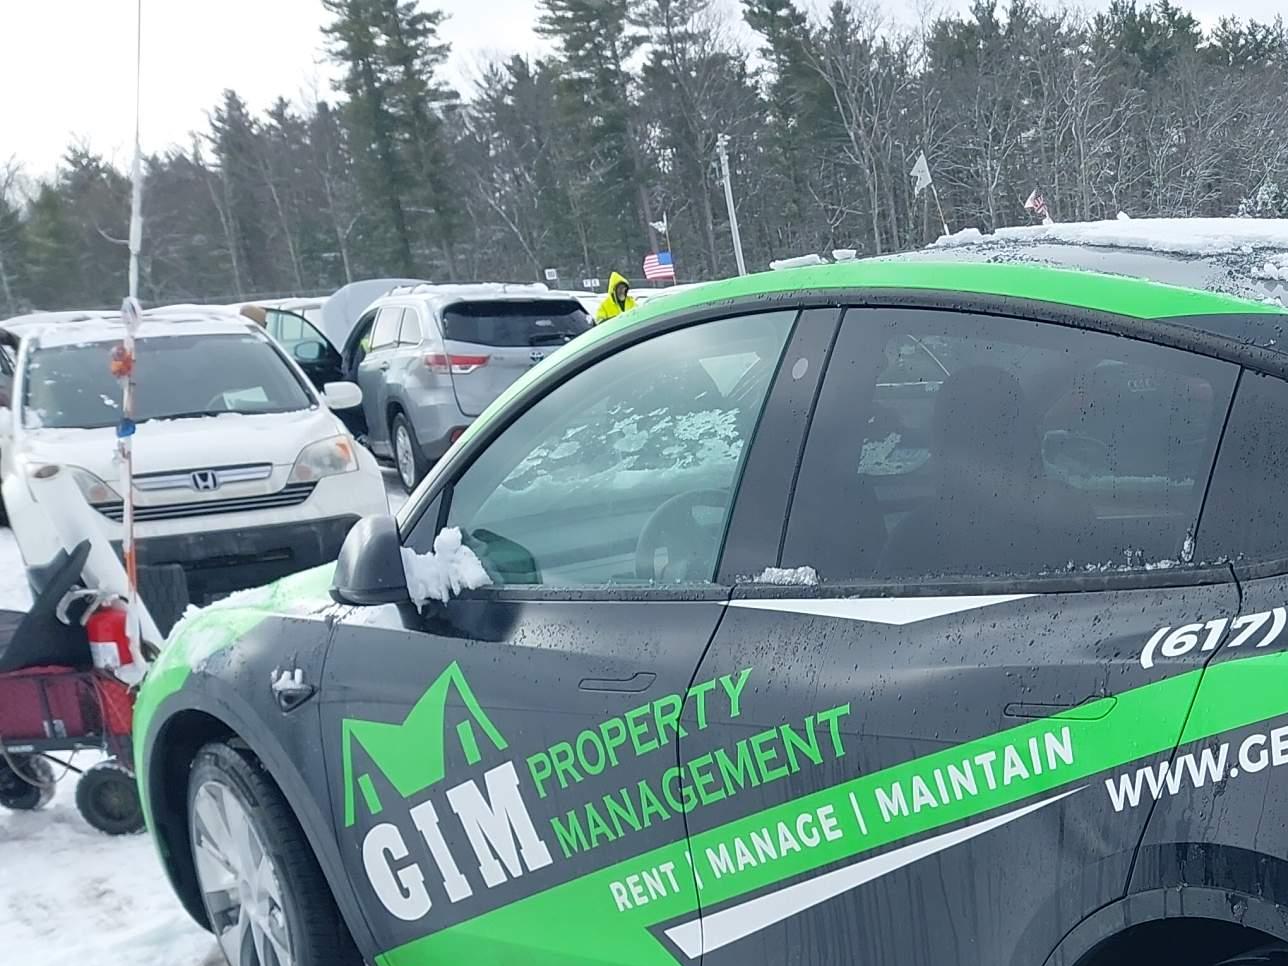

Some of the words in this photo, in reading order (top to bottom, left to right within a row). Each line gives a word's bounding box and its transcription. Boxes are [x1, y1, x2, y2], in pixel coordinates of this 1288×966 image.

[1140, 607, 1288, 669] (617)
[526, 667, 754, 798] PROPERTY
[550, 702, 851, 858] MANAGEMENT
[362, 761, 553, 922] GIM
[610, 861, 680, 913] RENT
[705, 805, 844, 881] MANAGE
[875, 726, 1075, 823] MAINTAIN
